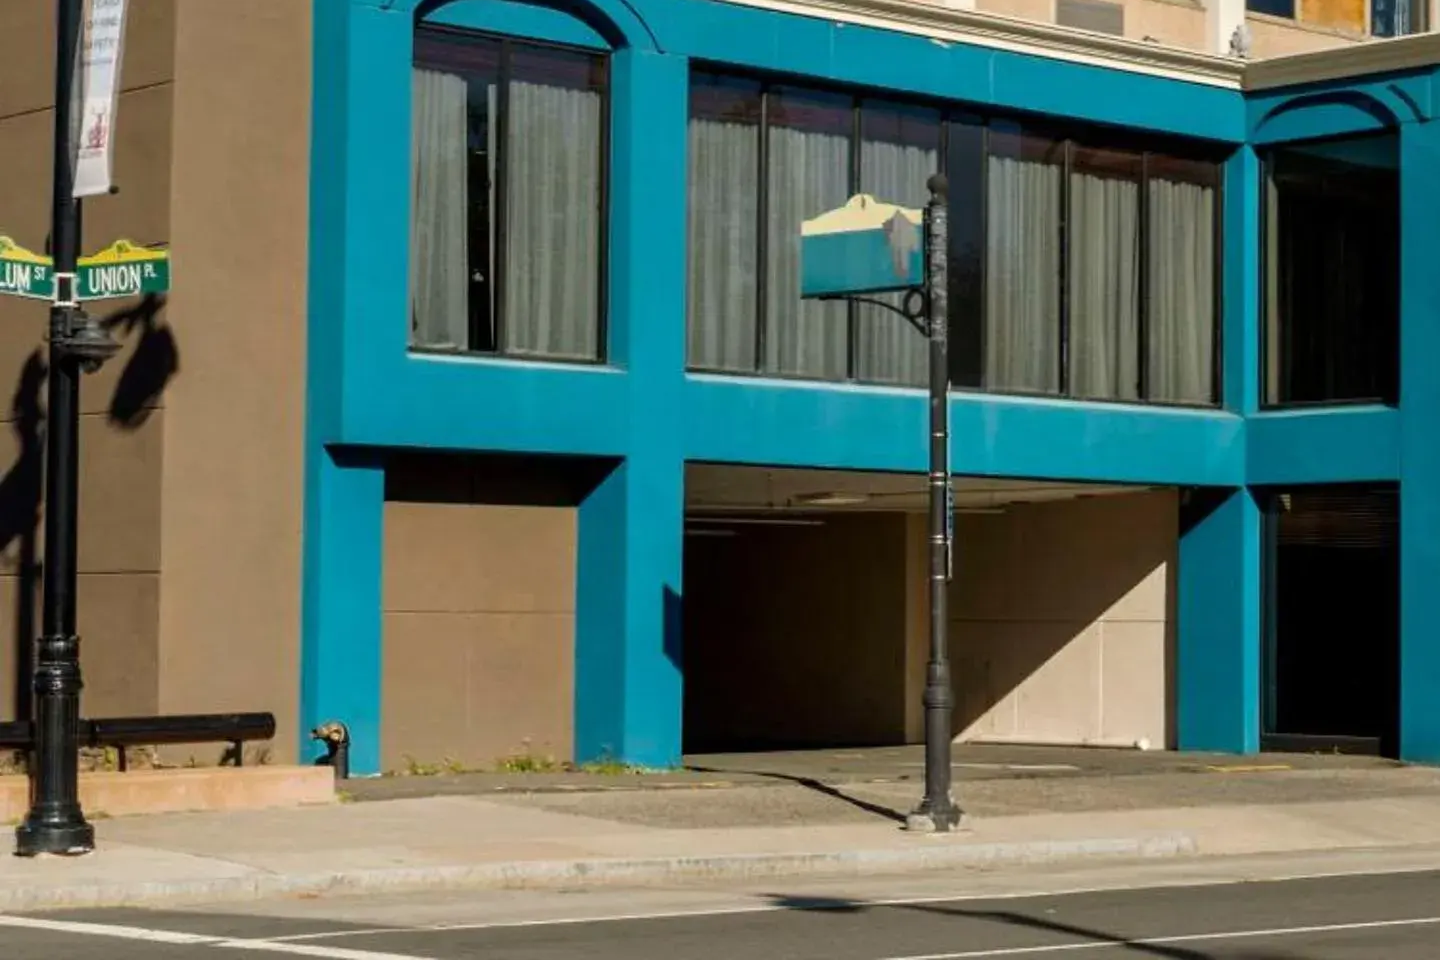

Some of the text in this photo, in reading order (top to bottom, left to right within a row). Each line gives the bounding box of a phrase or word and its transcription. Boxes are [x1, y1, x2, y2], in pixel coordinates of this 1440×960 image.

[34, 266, 47, 281] ST
[88, 263, 158, 293] UNION PL
